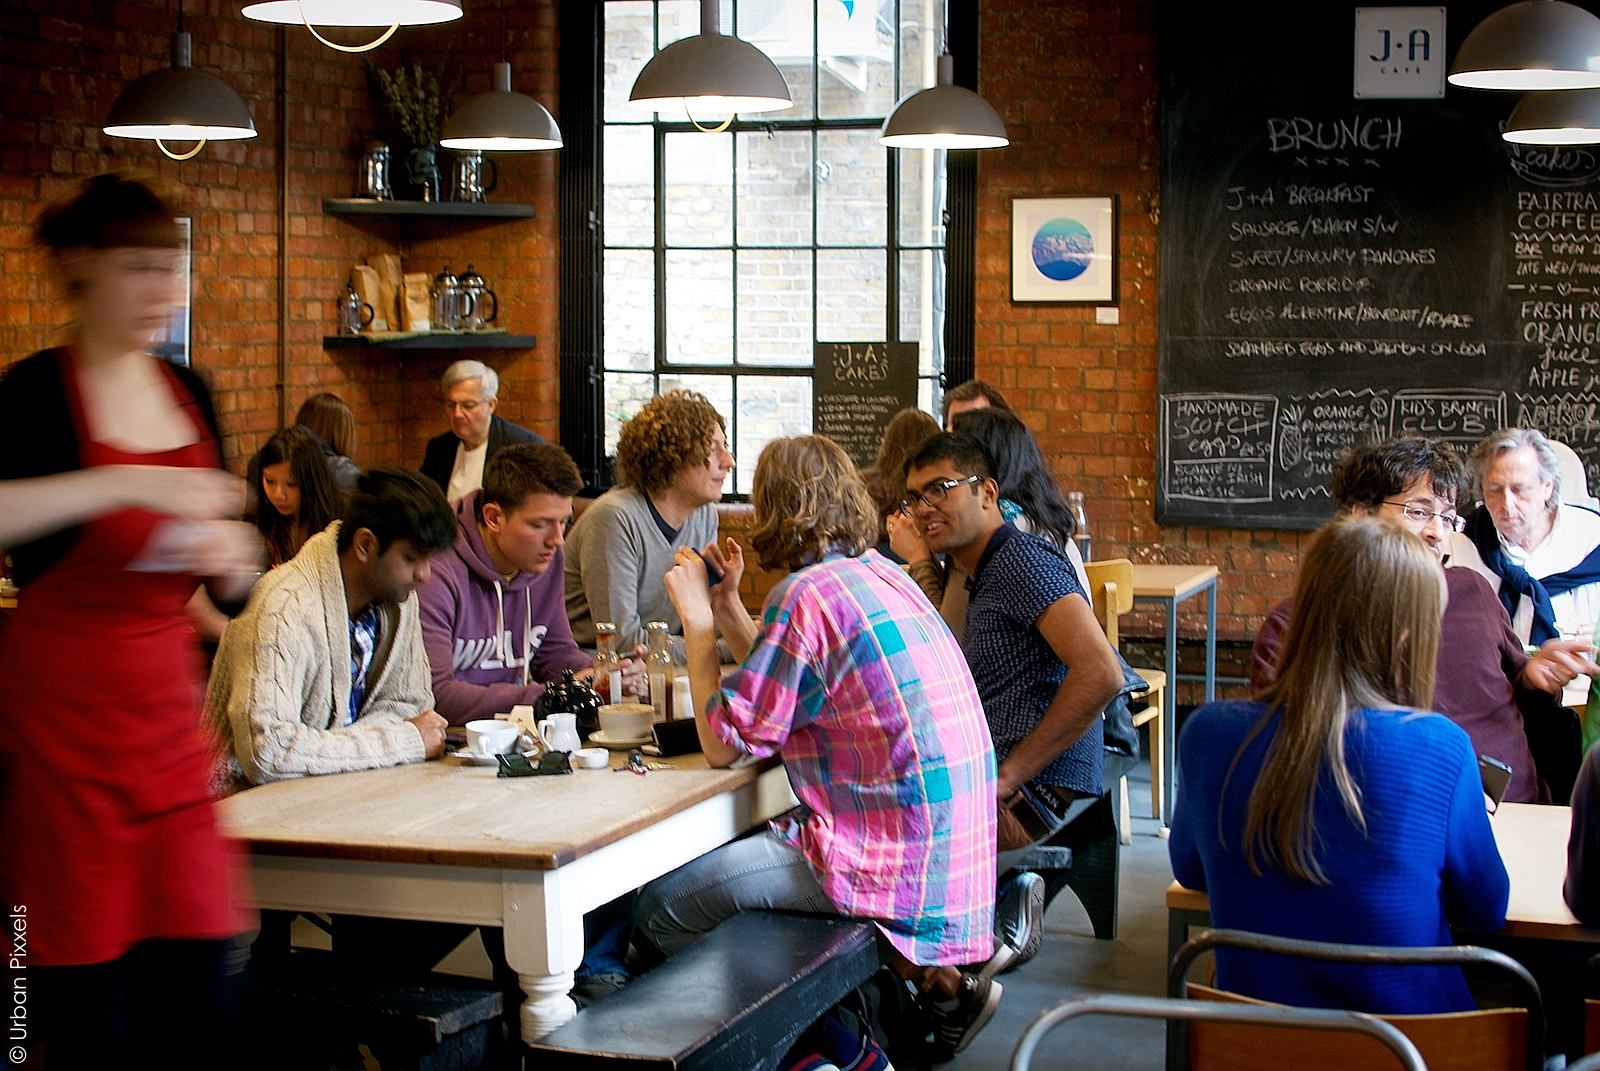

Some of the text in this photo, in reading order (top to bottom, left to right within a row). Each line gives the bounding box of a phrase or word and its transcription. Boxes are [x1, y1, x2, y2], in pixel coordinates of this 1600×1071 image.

[1267, 115, 1401, 152] BRUNCH
[1285, 182, 1375, 206] BREAKFAST
[1518, 191, 1600, 211] FAIRTRA
[1517, 211, 1600, 231] COFFEE
[1361, 247, 1437, 266] PANCAKES
[1521, 301, 1574, 320] FRESH
[1539, 344, 1598, 370] juice
[834, 361, 889, 382] CAKES
[1528, 366, 1580, 388] APPLE
[1177, 400, 1265, 418] HANDMADE
[1441, 400, 1497, 420] BRUNCH
[1402, 414, 1486, 433] CLUB
